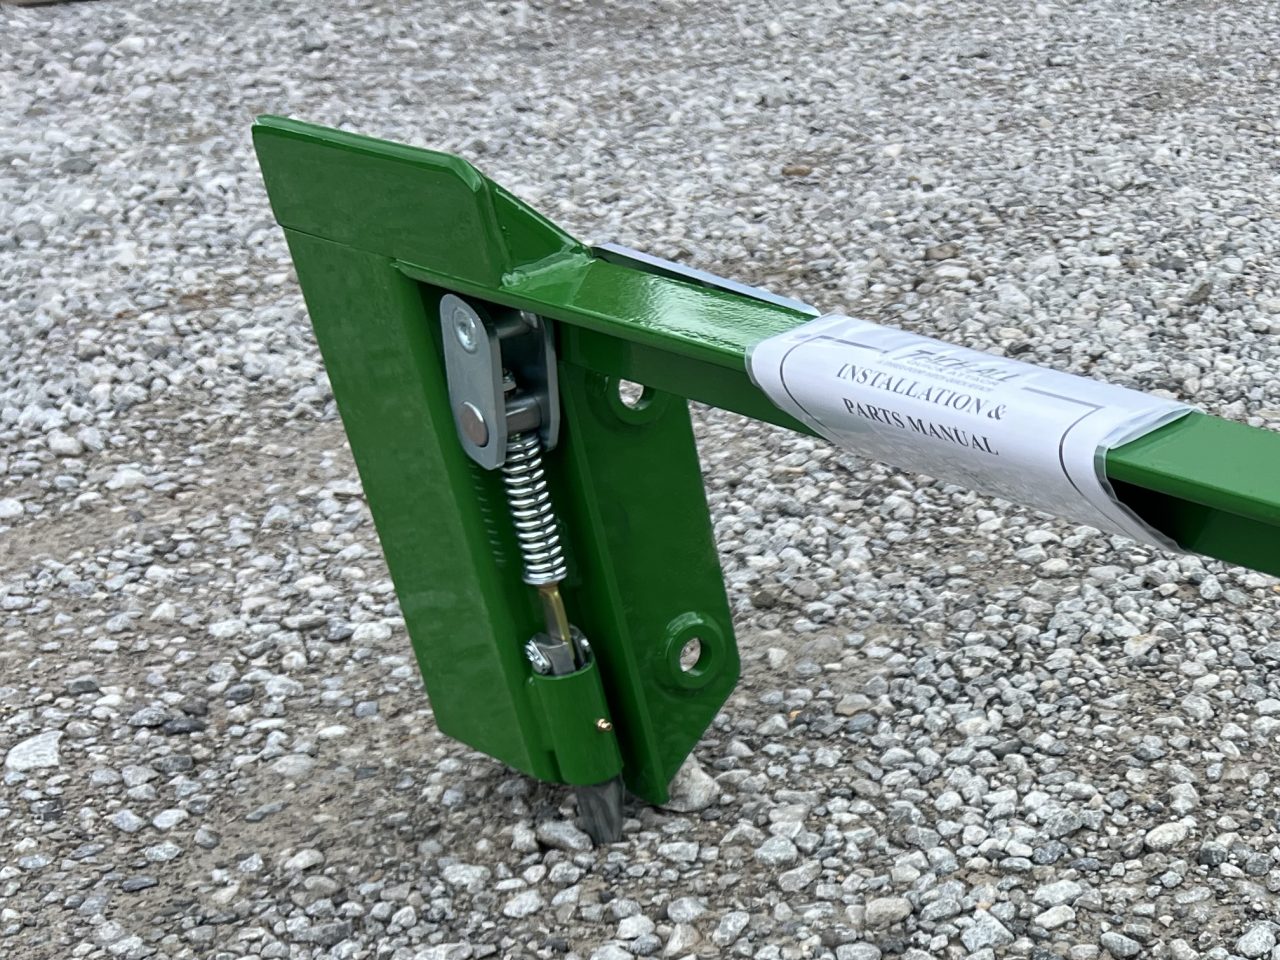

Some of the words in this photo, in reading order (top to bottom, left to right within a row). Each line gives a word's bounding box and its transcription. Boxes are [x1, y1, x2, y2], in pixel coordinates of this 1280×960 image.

[836, 363, 986, 415] INSTALLATION
[987, 403, 1007, 420] &
[842, 397, 906, 428] PARTS
[906, 415, 1000, 456] MANUAL
